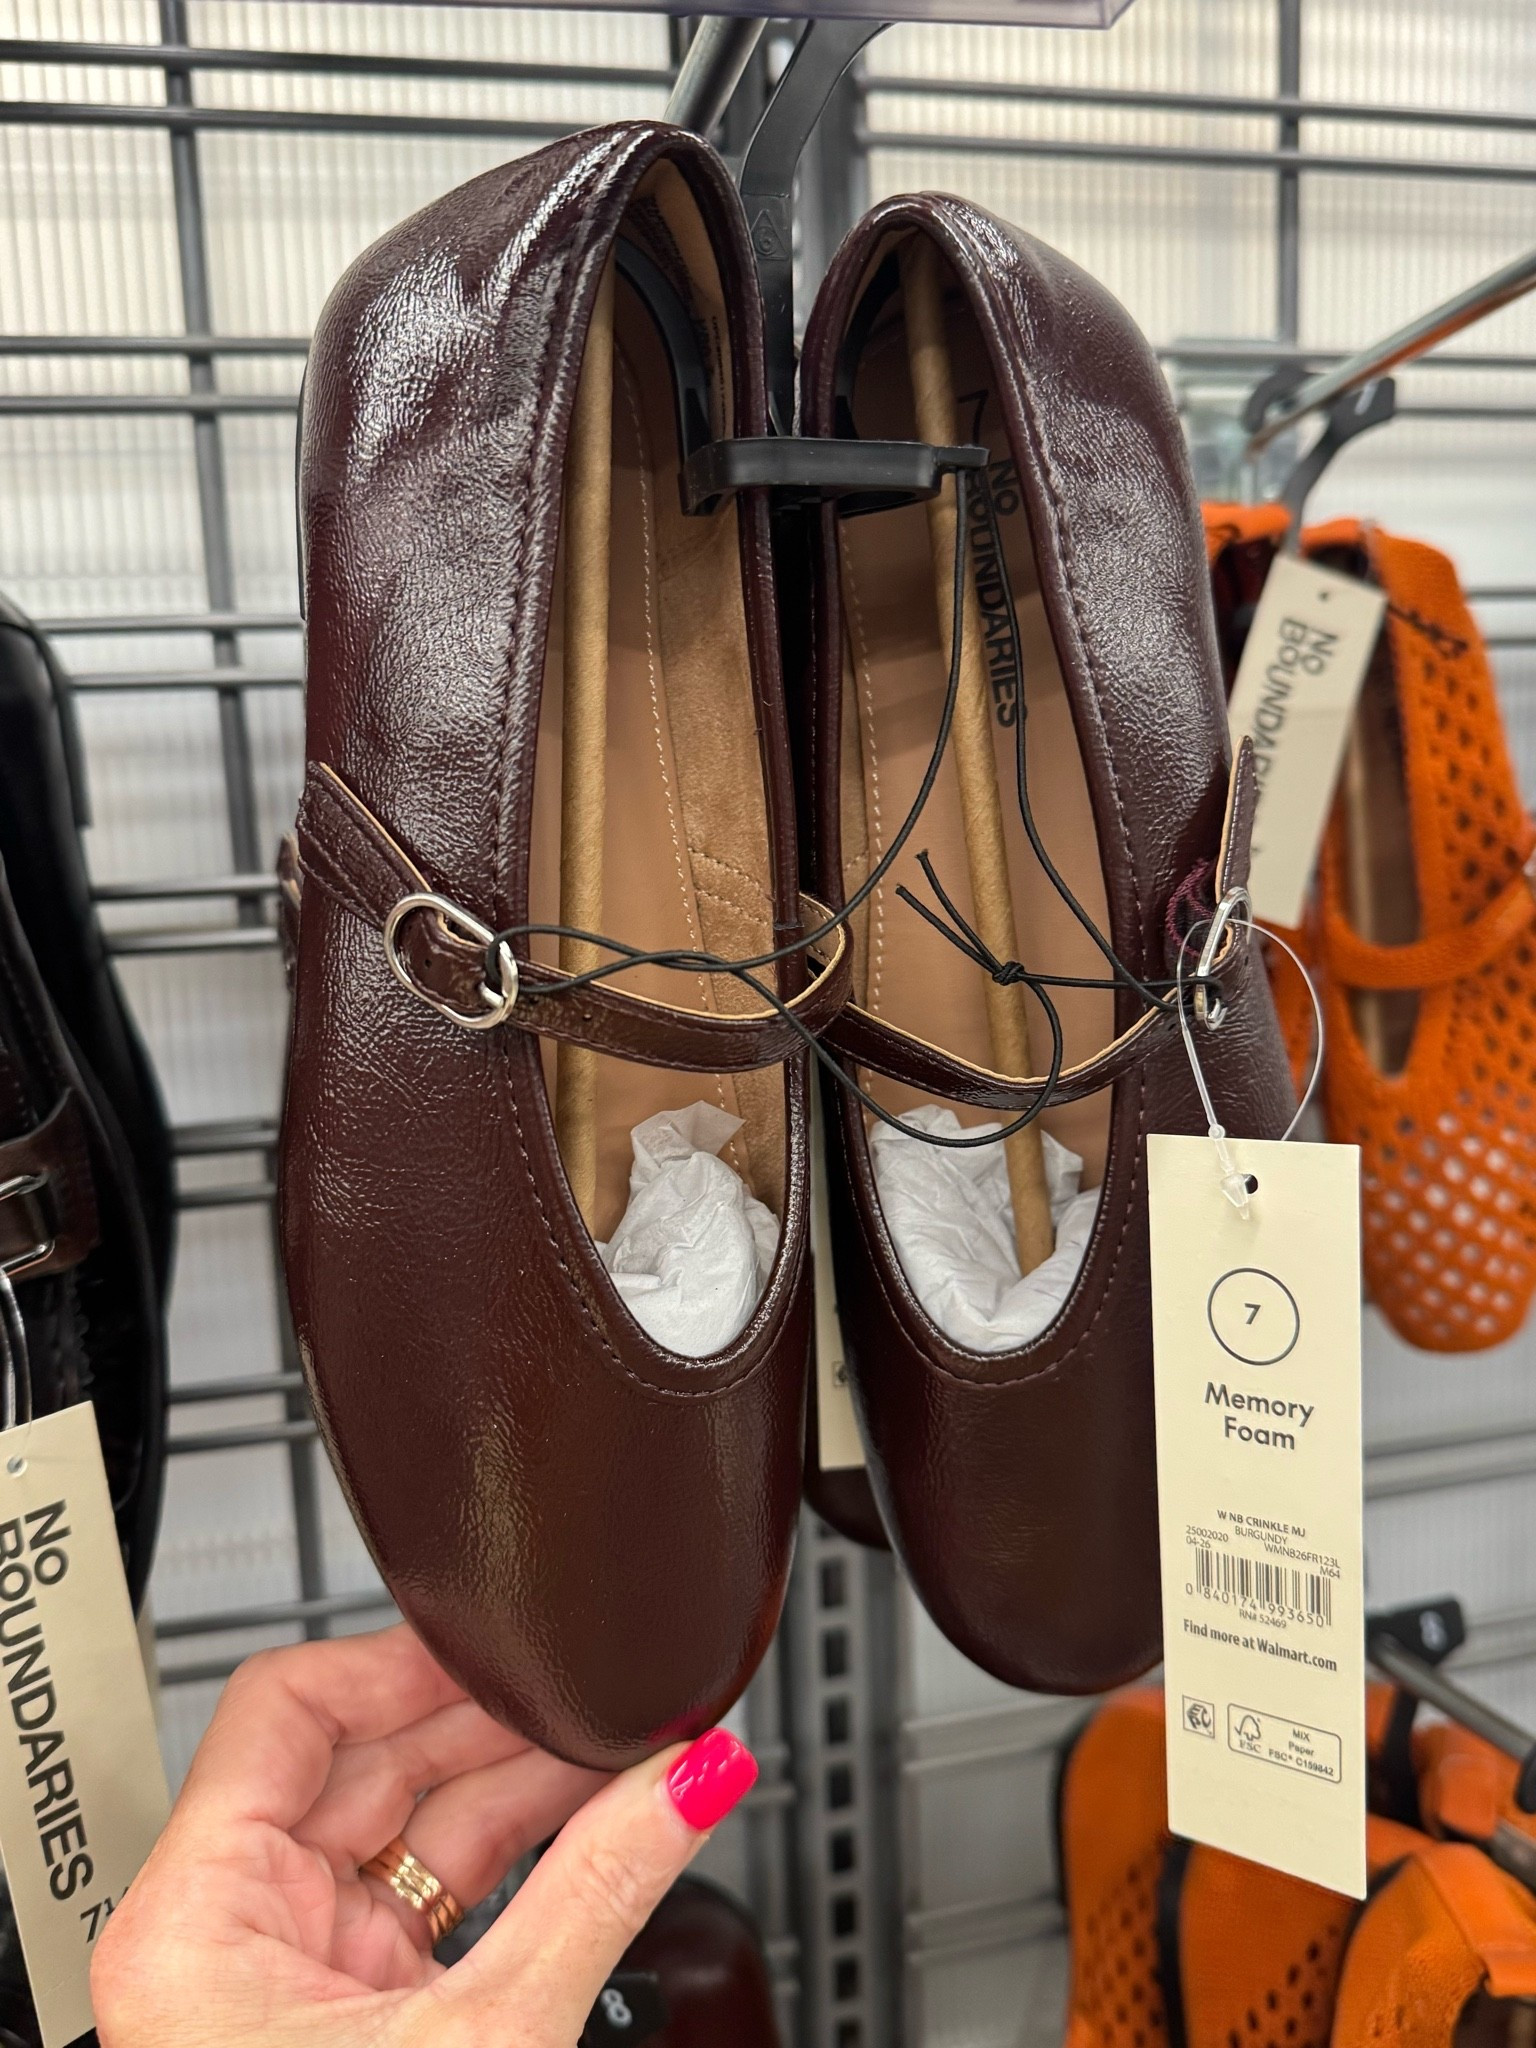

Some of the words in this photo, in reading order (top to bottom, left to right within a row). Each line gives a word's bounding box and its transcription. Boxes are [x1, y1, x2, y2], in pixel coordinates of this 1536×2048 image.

[988, 458, 1020, 517] NO
[1301, 625, 1339, 676] NO
[1244, 1302, 1261, 1325] 7
[1204, 1381, 1315, 1428] Memory
[1224, 1415, 1296, 1450] Foam
[1185, 1525, 1229, 1543] 25002020
[1216, 1509, 1227, 1520] W
[1229, 1512, 1244, 1524] NB
[1245, 1516, 1289, 1535] CRINKLE
[1291, 1527, 1306, 1538] MJ
[1234, 1525, 1288, 1545] BURGUNDY
[24, 1498, 72, 1586] NO
[1186, 1535, 1211, 1549] 04-26
[1263, 1542, 1341, 1569] WMNB26FR123L
[1319, 1565, 1341, 1580] M64
[1186, 1582, 1193, 1596] 0
[1203, 1587, 1257, 1611] 840174
[1268, 1603, 1324, 1628] 993650
[1239, 1608, 1257, 1622] RN#
[1259, 1611, 1287, 1629] 52469
[1183, 1618, 1208, 1637] Find
[1210, 1625, 1240, 1646] more
[1242, 1634, 1256, 1650] at
[1256, 1637, 1338, 1672] Walmart.com
[1239, 1739, 1261, 1753] FSC
[1288, 1740, 1315, 1757] Paper
[601, 1988, 633, 2028] 8
